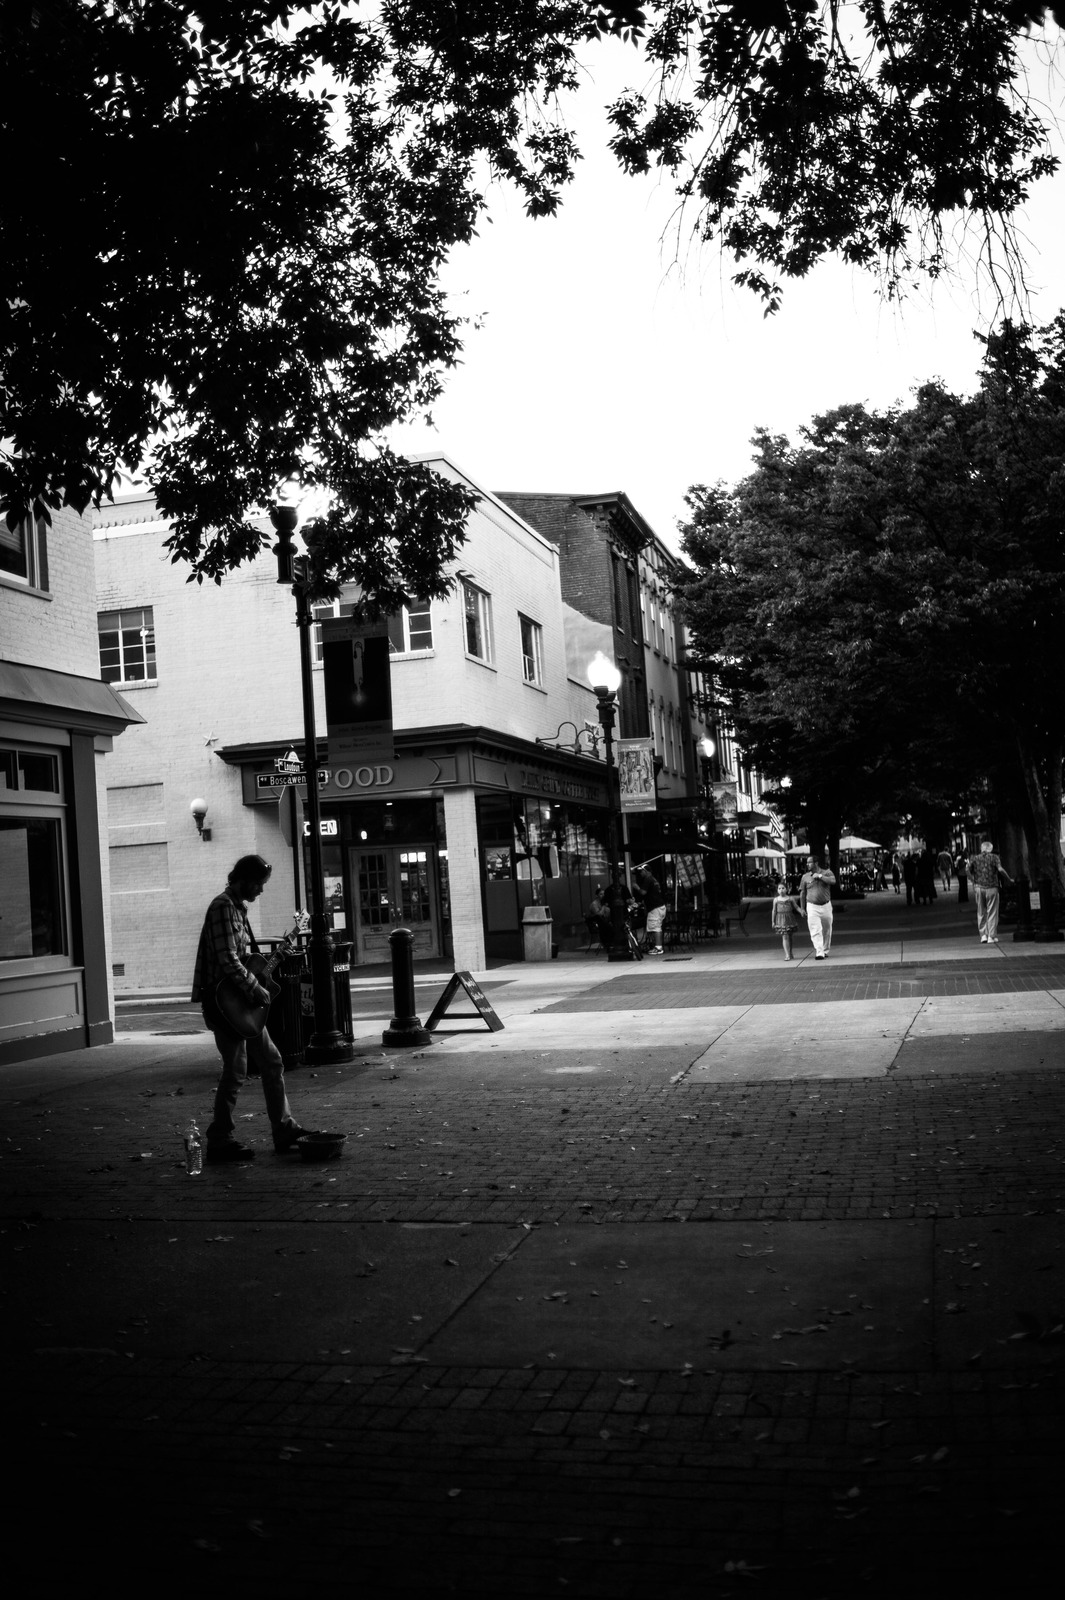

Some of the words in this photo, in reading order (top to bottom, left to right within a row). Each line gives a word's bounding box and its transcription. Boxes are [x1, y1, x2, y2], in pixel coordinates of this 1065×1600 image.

[283, 761, 301, 772] Loudoun
[269, 775, 307, 786] Boscawen
[303, 820, 338, 837] OEN
